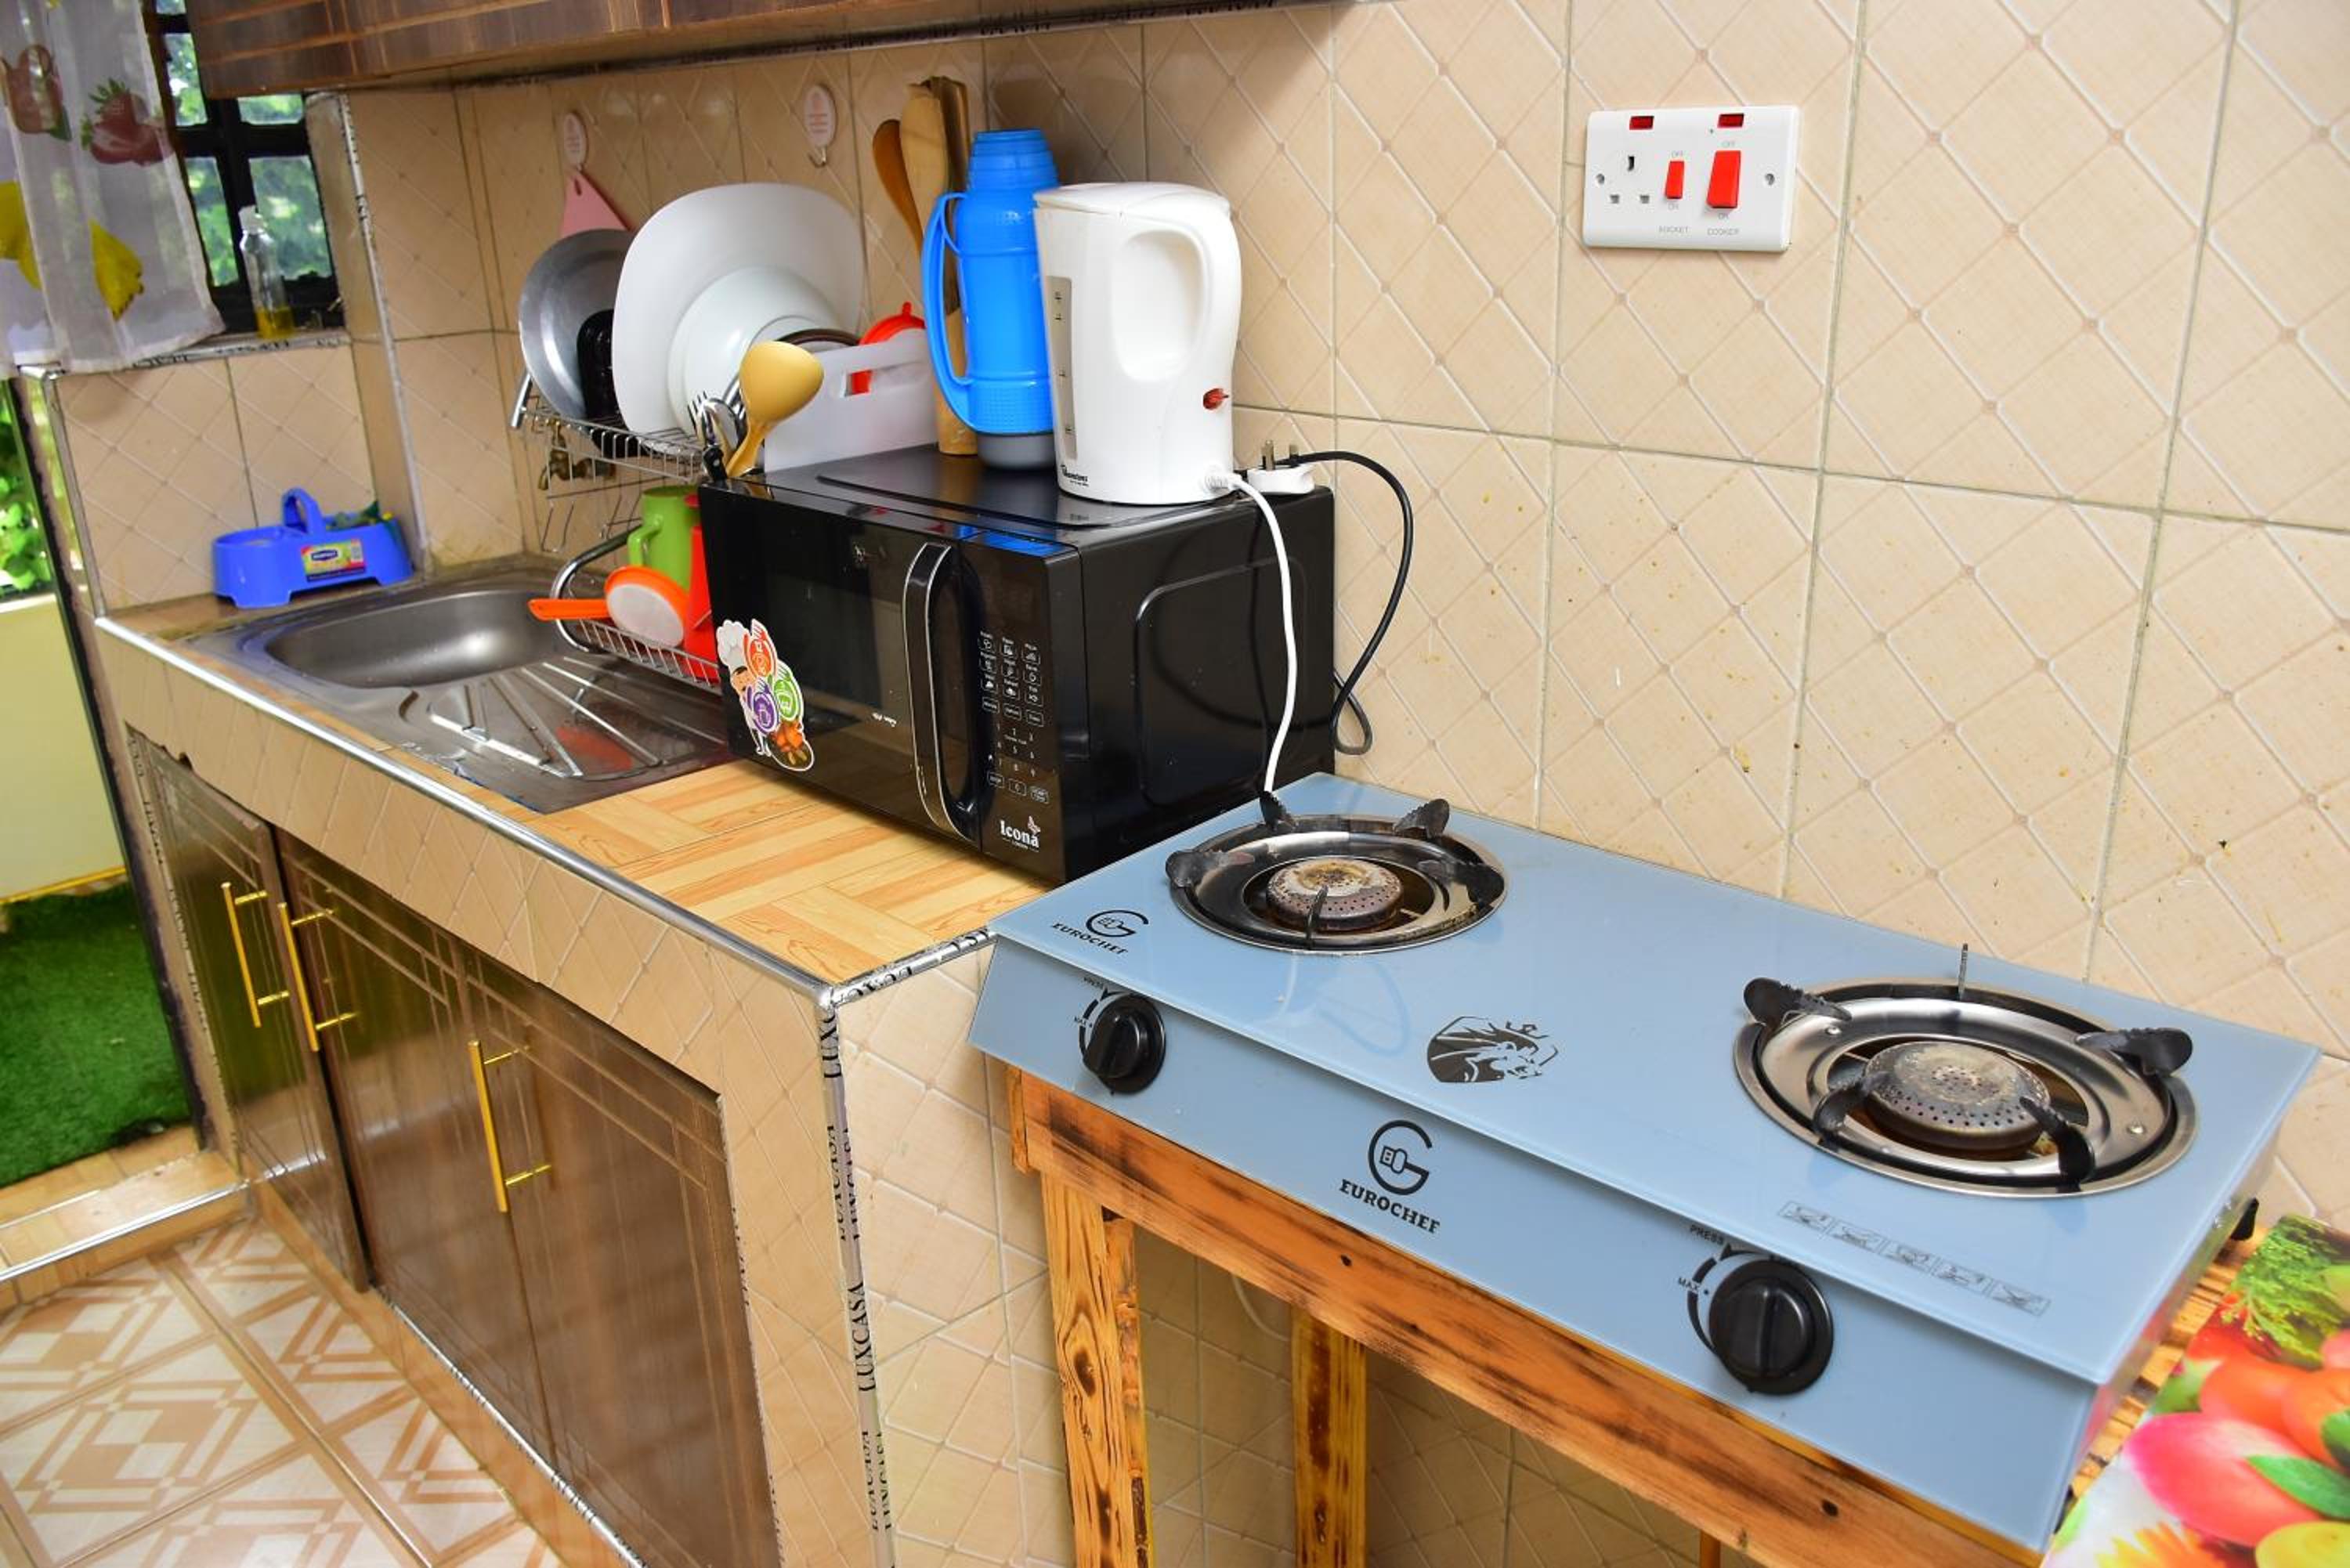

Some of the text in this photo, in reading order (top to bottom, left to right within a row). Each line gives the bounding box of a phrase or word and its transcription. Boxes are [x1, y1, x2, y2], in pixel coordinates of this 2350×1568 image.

[1000, 819, 1039, 848] Icona
[1051, 923, 1129, 954] EUROCHEF
[1339, 1179, 1441, 1234] EUROCHEF
[847, 1281, 876, 1392] LUXCASA
